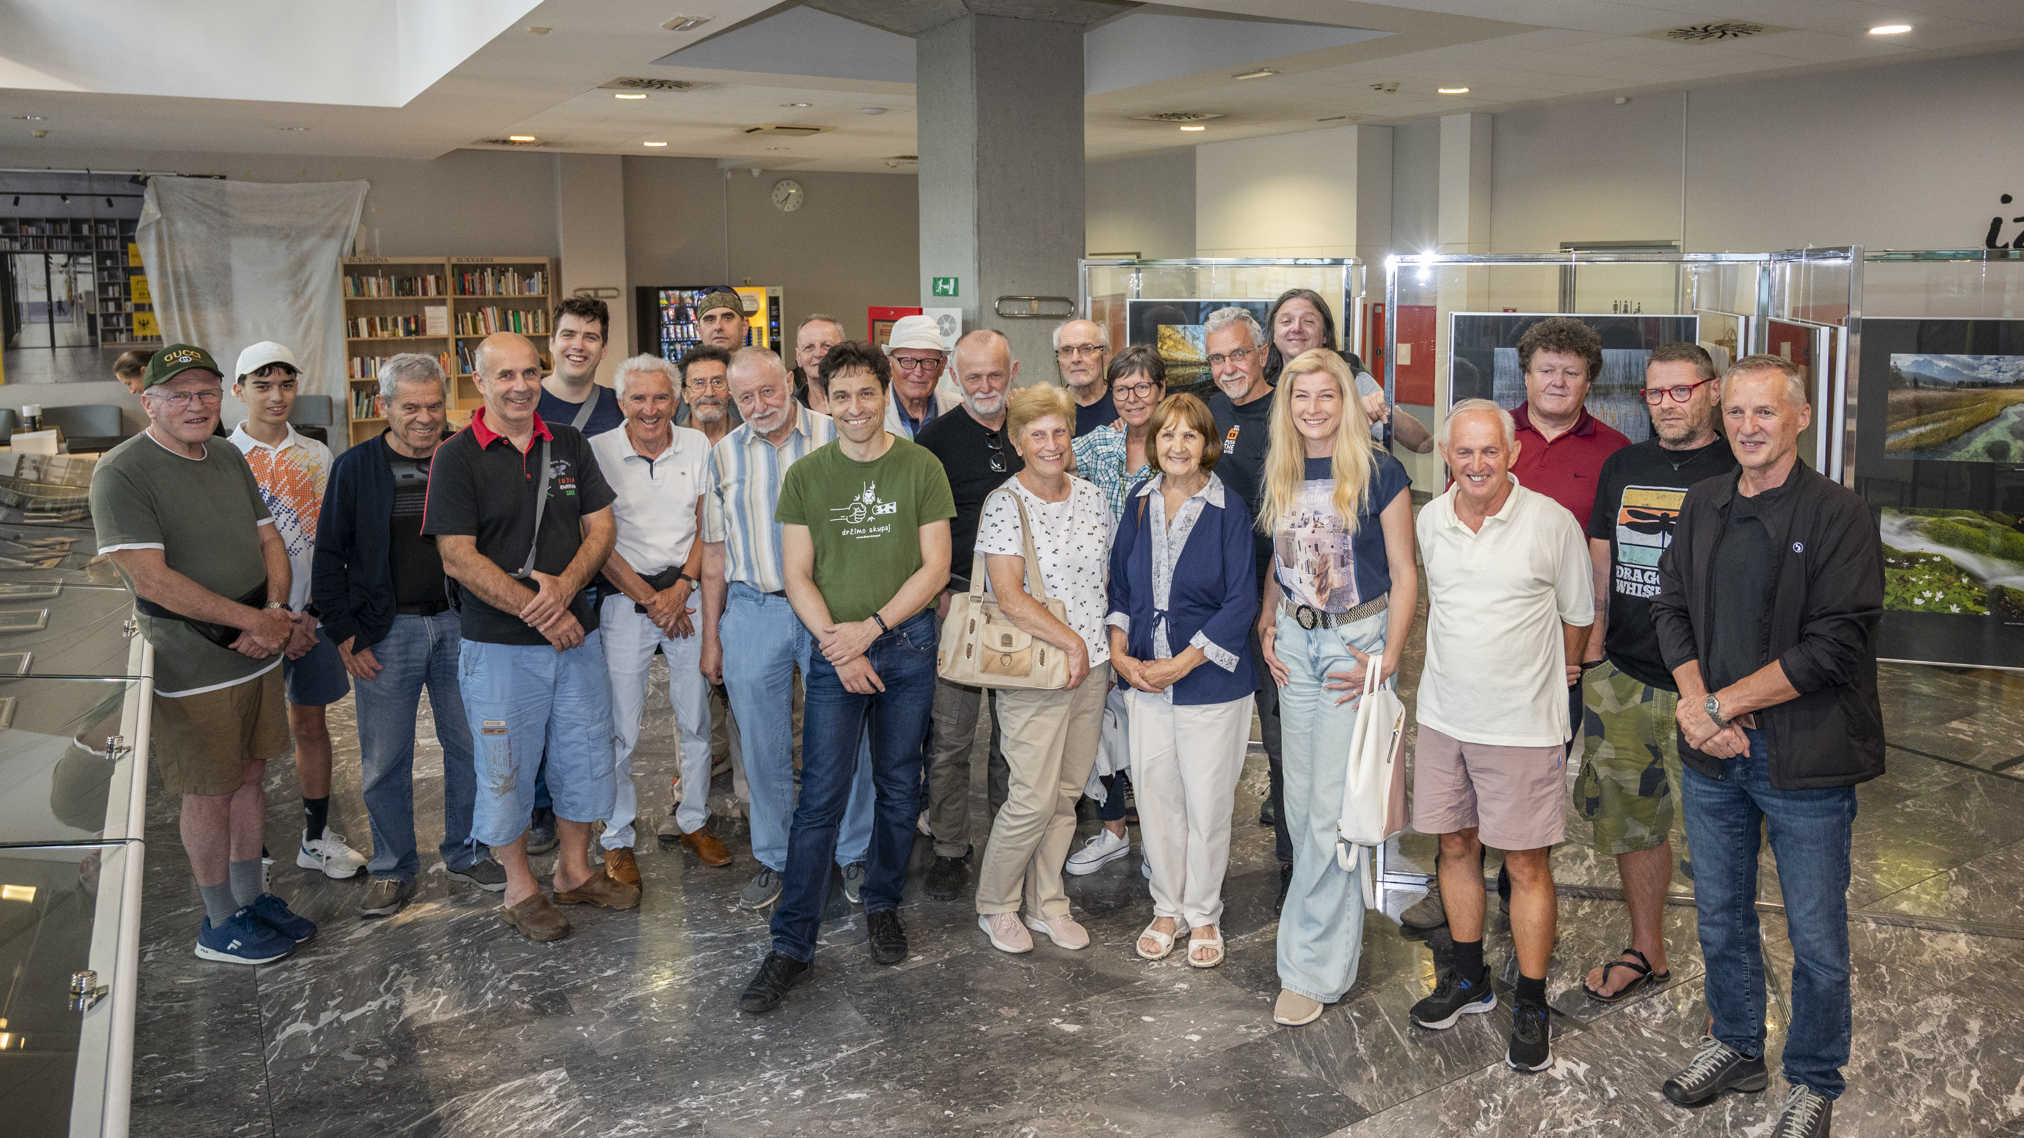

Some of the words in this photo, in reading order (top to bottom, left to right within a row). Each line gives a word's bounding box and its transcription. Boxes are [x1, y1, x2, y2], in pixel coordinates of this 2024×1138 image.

[164, 349, 202, 362] GUCCI
[558, 477, 575, 485] INDIA
[841, 527, 867, 536] držimo
[868, 523, 891, 534] skupaj
